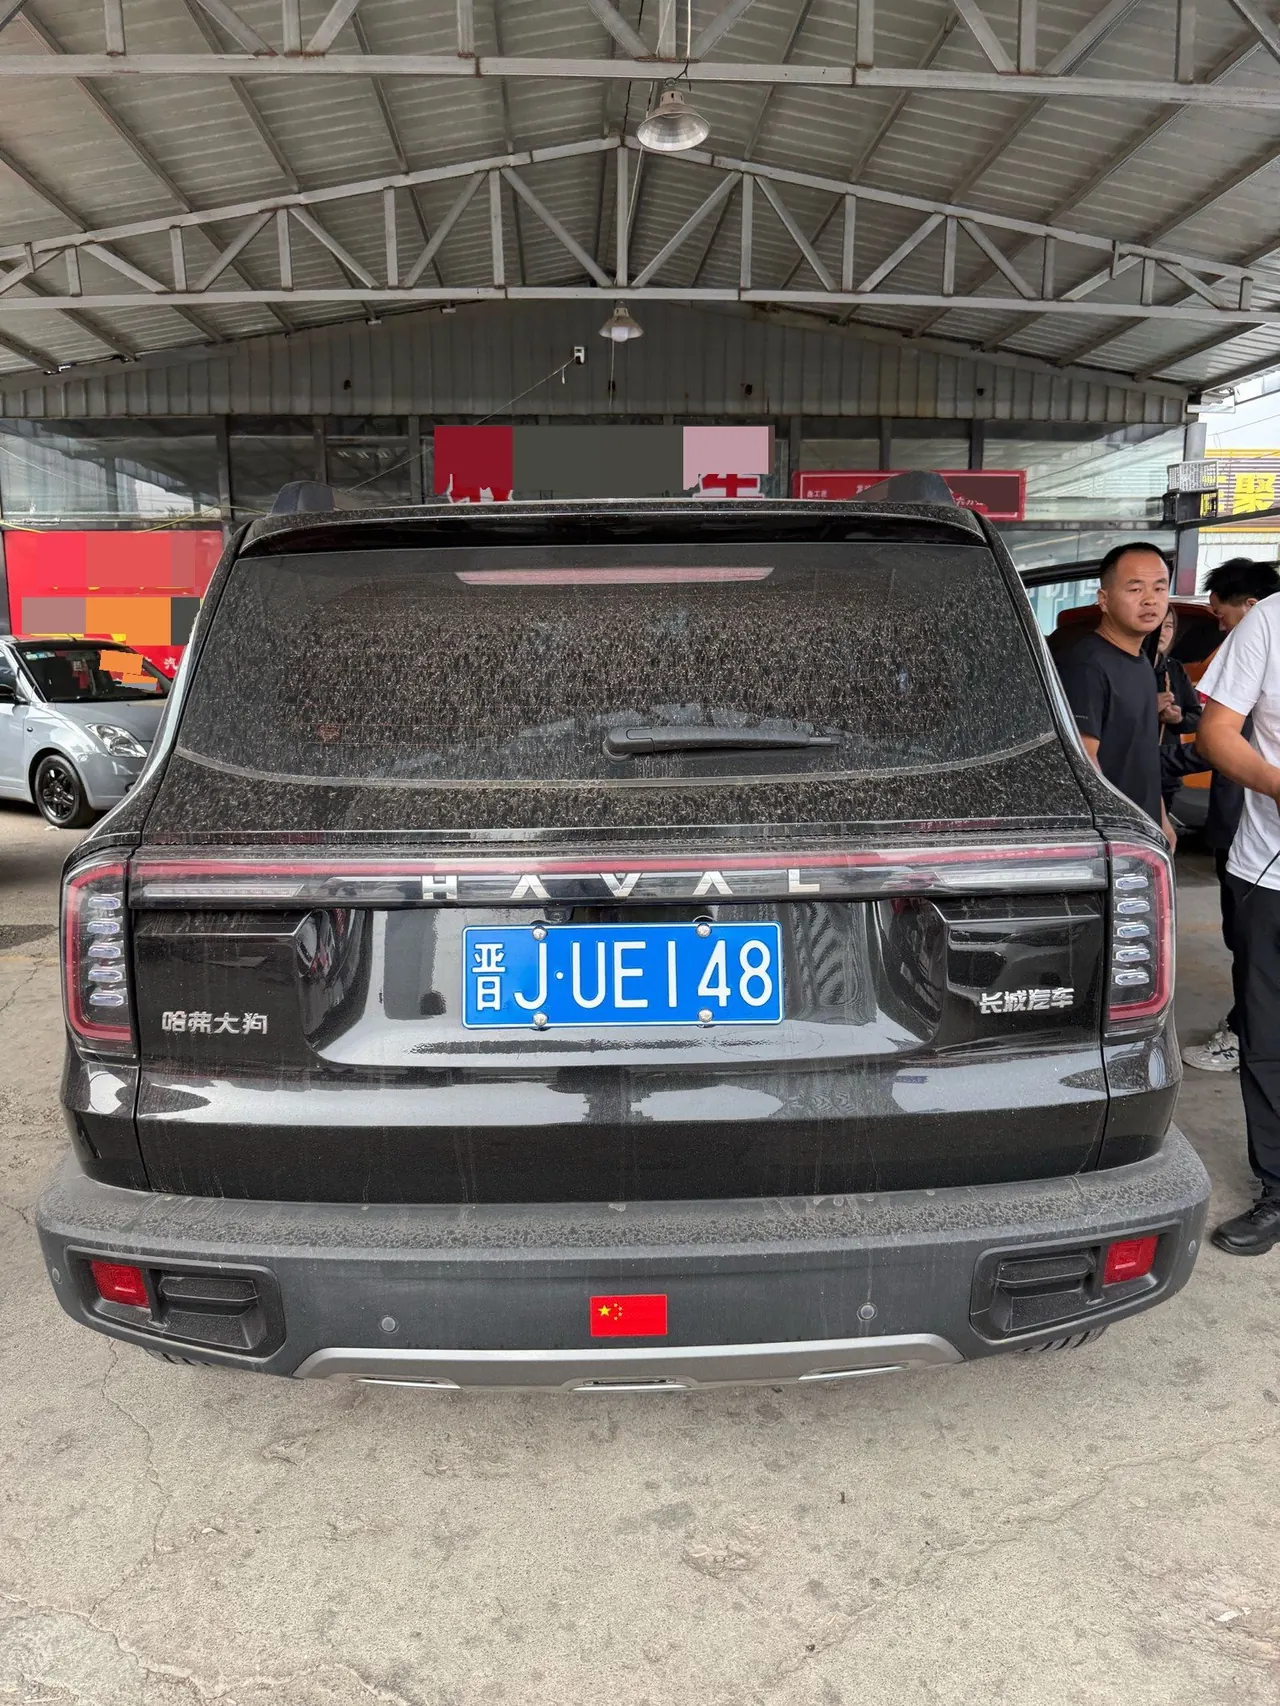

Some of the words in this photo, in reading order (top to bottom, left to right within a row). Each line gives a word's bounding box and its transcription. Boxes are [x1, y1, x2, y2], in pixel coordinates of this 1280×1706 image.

[422, 869, 820, 900] HAVAL
[980, 987, 1074, 1014] 长城汽车
[162, 1010, 268, 1035] 哈弗大狗
